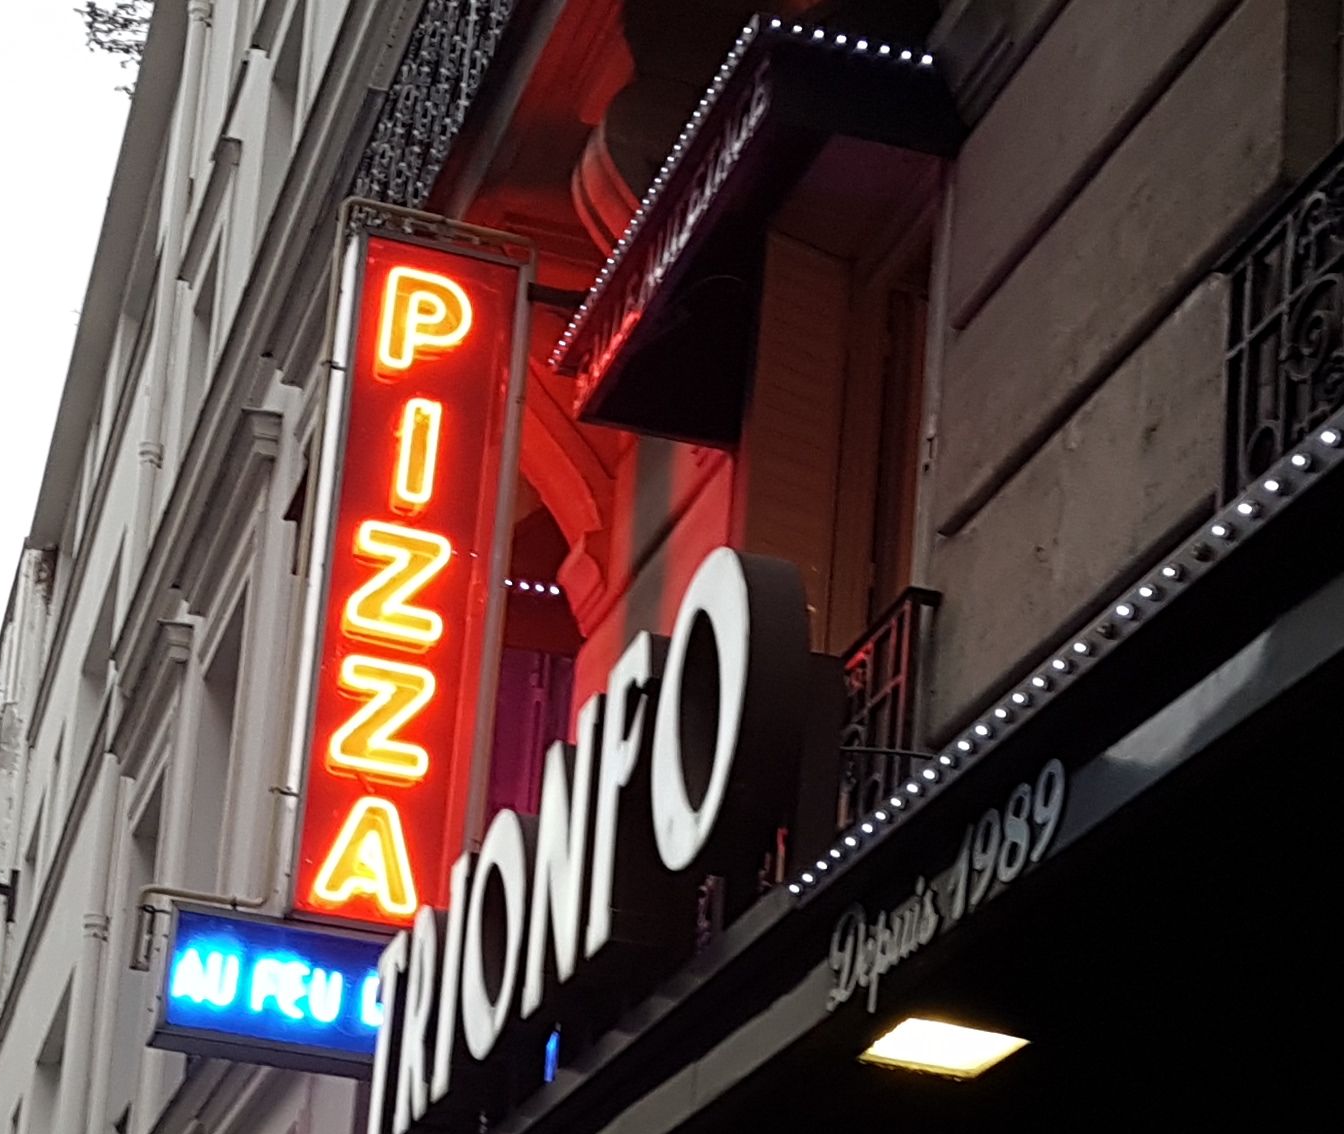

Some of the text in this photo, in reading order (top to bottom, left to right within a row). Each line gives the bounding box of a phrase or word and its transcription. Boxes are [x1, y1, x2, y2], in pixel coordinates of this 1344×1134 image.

[312, 266, 473, 917] PIZZA
[170, 948, 239, 1006] AU
[251, 958, 343, 1022] FEU
[826, 758, 1065, 1013] Depuis 1989
